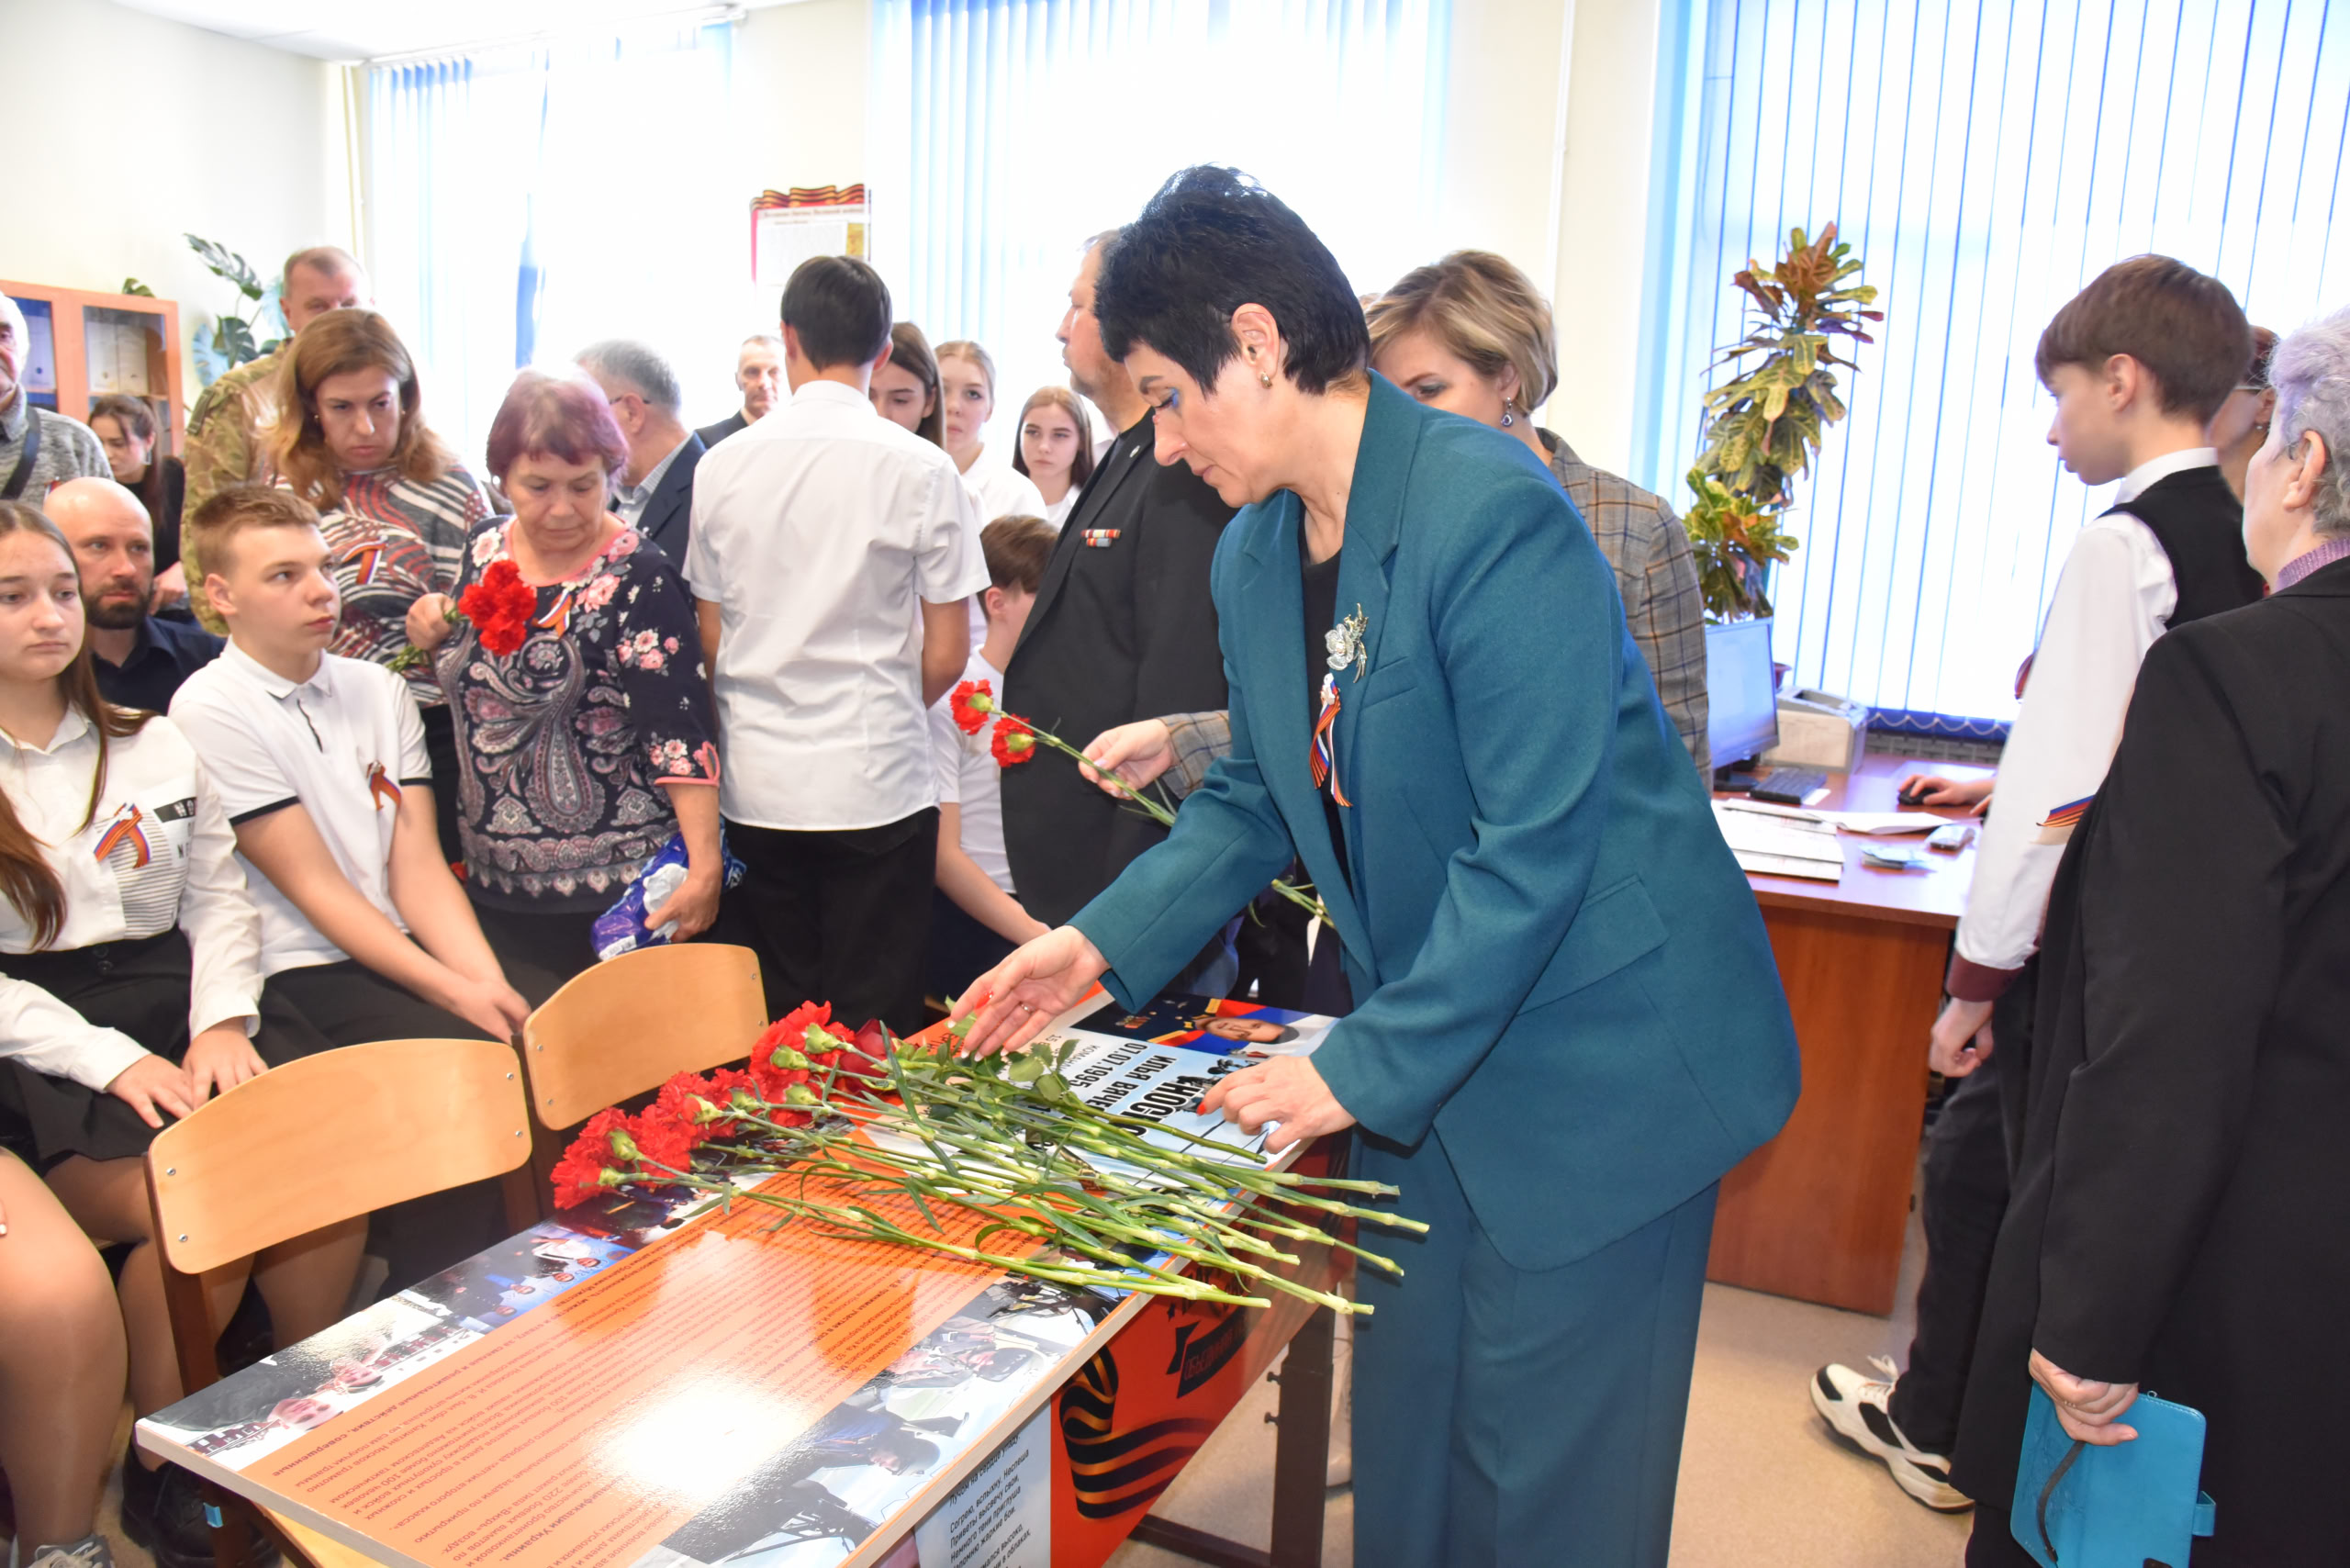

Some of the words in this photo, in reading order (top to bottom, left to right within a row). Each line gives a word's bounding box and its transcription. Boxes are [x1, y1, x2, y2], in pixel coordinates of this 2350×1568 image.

[1069, 1042, 1148, 1088] 07.07.1995
[1125, 1054, 1177, 1081] ИЛЬЯ
[467, 1346, 505, 1365] смелые
[395, 1369, 463, 1406] решительные
[443, 1400, 467, 1411] был
[483, 1394, 513, 1410] наших
[548, 1395, 568, 1406] 100
[344, 1405, 401, 1434] действия,
[423, 1409, 450, 1423] сбит.
[456, 1410, 487, 1427] войск
[475, 1411, 504, 1428] Всего
[518, 1405, 553, 1425] боевых
[367, 1433, 389, 1444] сам
[386, 1423, 428, 1445] Капитан
[422, 1426, 479, 1457] уничтожено
[439, 1429, 491, 1460] поддержку
[483, 1424, 521, 1446] вылетов
[268, 1433, 349, 1476] совершенные
[329, 1443, 371, 1465] получил
[351, 1445, 390, 1465] Носков
[387, 1433, 449, 1467] Авдеевском
[457, 1445, 487, 1461] днем
[496, 1438, 536, 1462] разряда
[509, 1441, 569, 1478] специальные
[291, 1464, 334, 1487] травмы
[388, 1459, 444, 1490] сухопутных
[397, 1457, 430, 1473] более
[412, 1465, 454, 1489] простых
[970, 1473, 979, 1485] на
[979, 1450, 1002, 1481] сердце
[302, 1464, 354, 1492] грамотно
[328, 1467, 391, 1503] тактическом
[378, 1473, 402, 1485] 100
[478, 1477, 515, 1498] задачи
[529, 1474, 559, 1492] ракет
[559, 1469, 590, 1487] более
[340, 1484, 382, 1508] человек
[360, 1491, 395, 1508] войск
[427, 1482, 468, 1506] второго
[510, 1492, 535, 1506] типа
[540, 1487, 565, 1500] 220
[542, 1480, 593, 1513] количество
[950, 1506, 975, 1534] Согрею,
[976, 1478, 1002, 1506] вспыхну.
[1003, 1449, 1029, 1478] Неспеша
[364, 1494, 408, 1520] сложных
[388, 1506, 433, 1531] класса».
[471, 1505, 516, 1531] «Вихрь»
[505, 1500, 544, 1524] боевых
[950, 1518, 978, 1549] Приветы
[979, 1490, 1003, 1519] высвечу
[1004, 1475, 1019, 1493] свои,
[411, 1506, 471, 1542] прикрытию
[950, 1533, 978, 1563] Немного
[978, 1518, 992, 1535] тени
[992, 1485, 1021, 1518] приглуша
[980, 1520, 1003, 1547] жаркие
[1003, 1506, 1015, 1522] бои.
[465, 1524, 509, 1551] вылетов
[470, 1512, 548, 1562] бронетанковой
[496, 1528, 554, 1562] Украины.
[557, 1531, 602, 1561] условиях
[606, 1530, 646, 1558] военное
[1001, 1523, 1024, 1551] высоко,
[580, 1540, 610, 1559] днем
